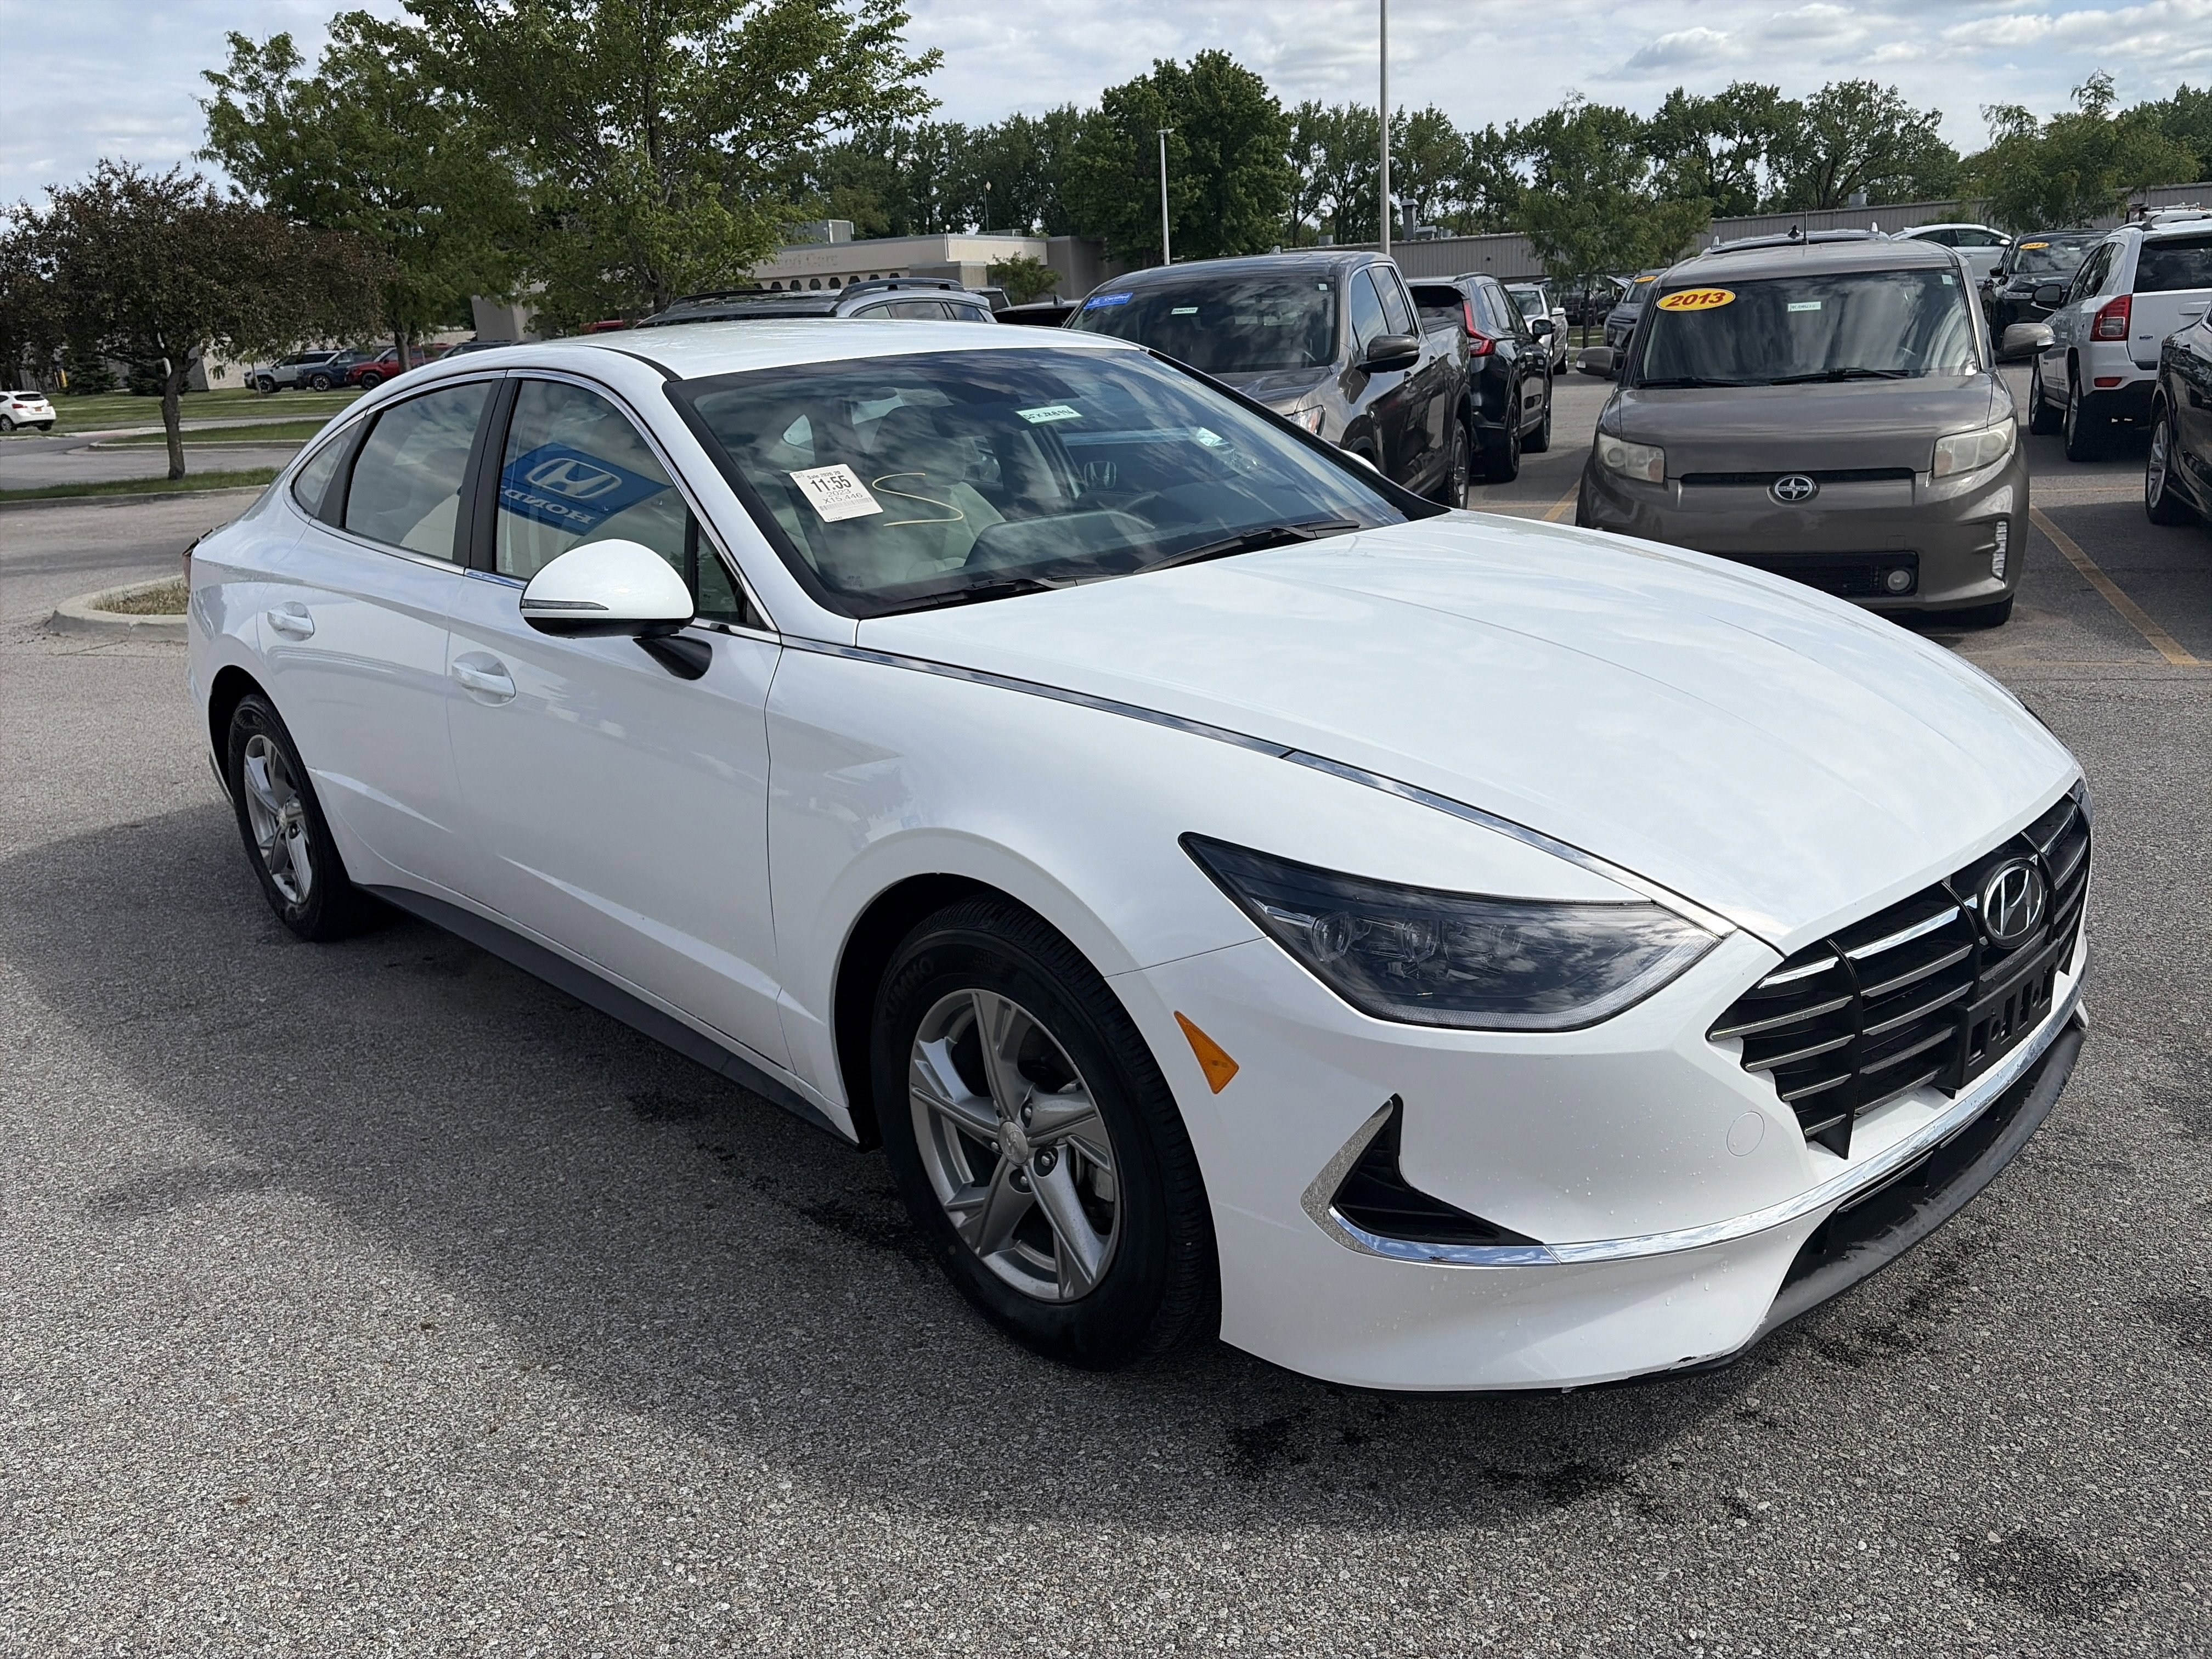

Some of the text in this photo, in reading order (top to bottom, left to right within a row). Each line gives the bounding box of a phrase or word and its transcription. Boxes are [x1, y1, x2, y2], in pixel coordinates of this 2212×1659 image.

[1666, 292, 1726, 307] 2013
[810, 475, 852, 493] 11:55
[826, 488, 851, 497] 2023
[872, 472, 963, 527] S
